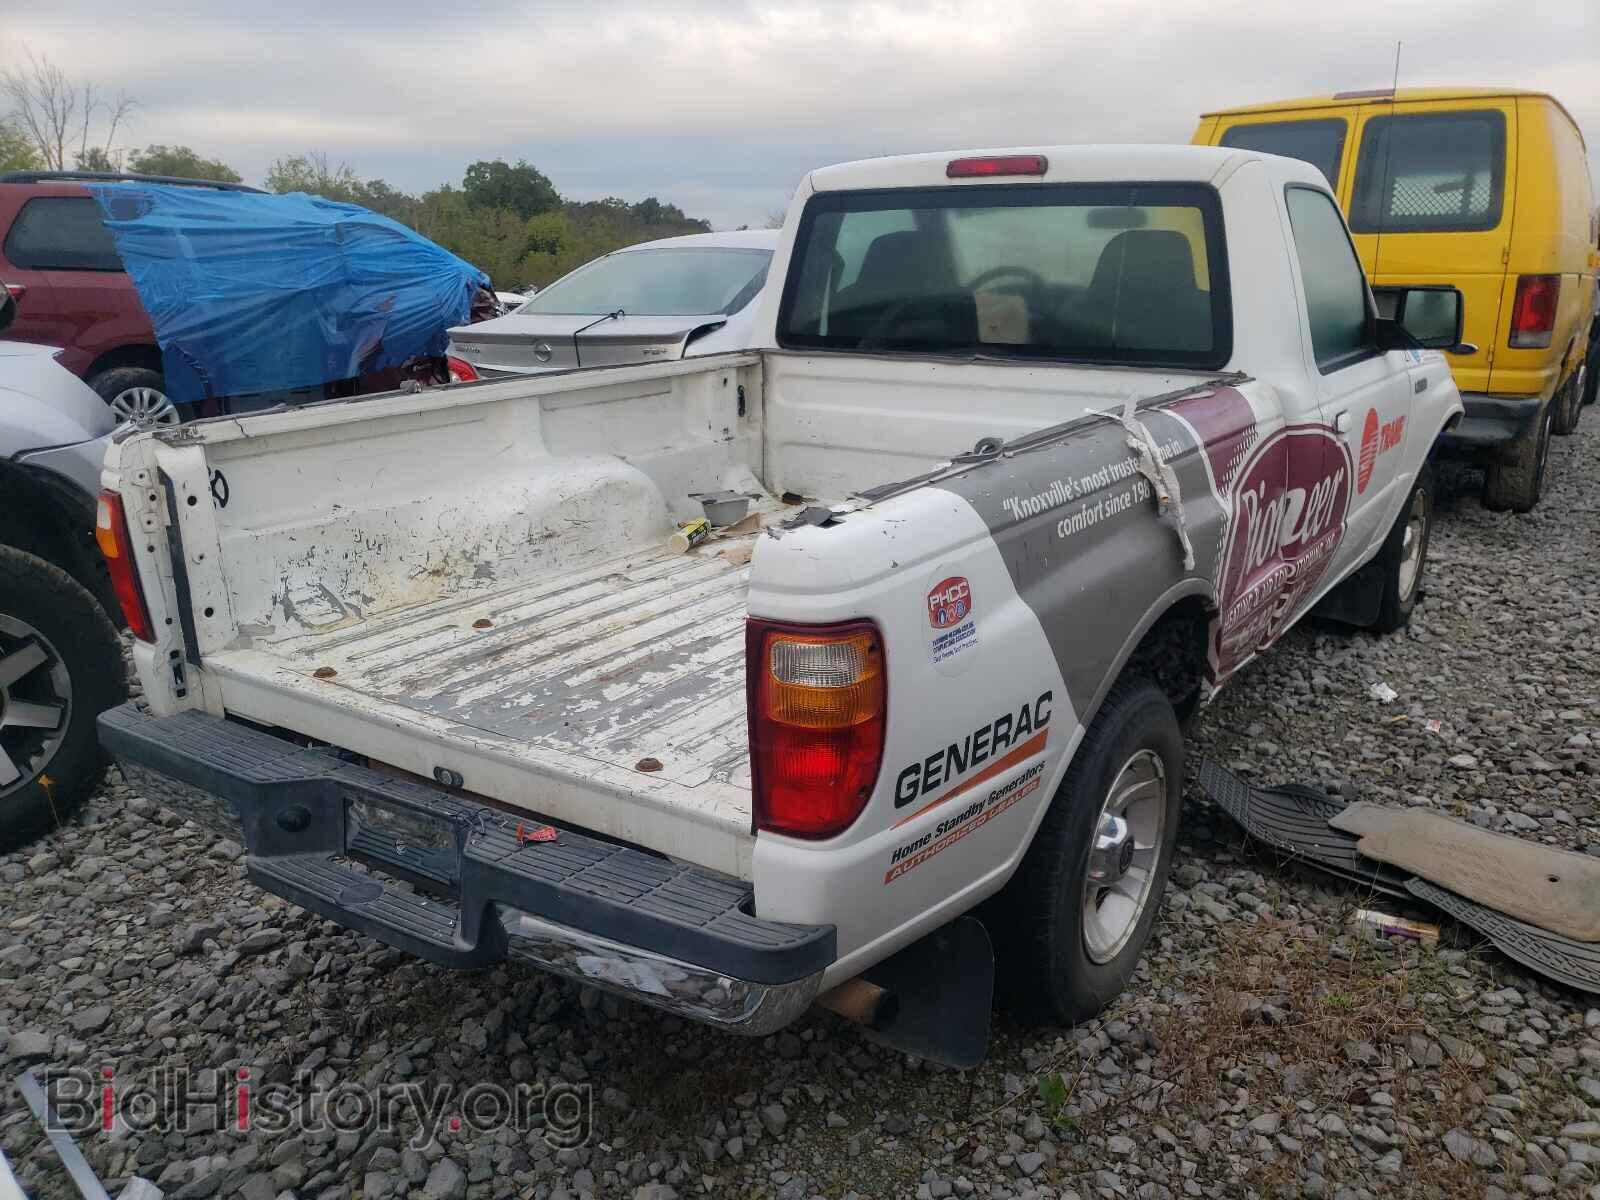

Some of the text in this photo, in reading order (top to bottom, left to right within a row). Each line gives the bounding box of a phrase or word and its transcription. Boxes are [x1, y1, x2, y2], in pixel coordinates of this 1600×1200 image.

[1082, 467, 1109, 493] most
[1108, 456, 1138, 482] truste
[1057, 478, 1151, 539] comfort since 198
[1234, 466, 1345, 595] Pioneer
[930, 581, 969, 611] PHCC
[894, 690, 1053, 810] GENERAC
[891, 760, 1046, 865] Home Standby Generators
[892, 814, 987, 881] AUTHORIZED
